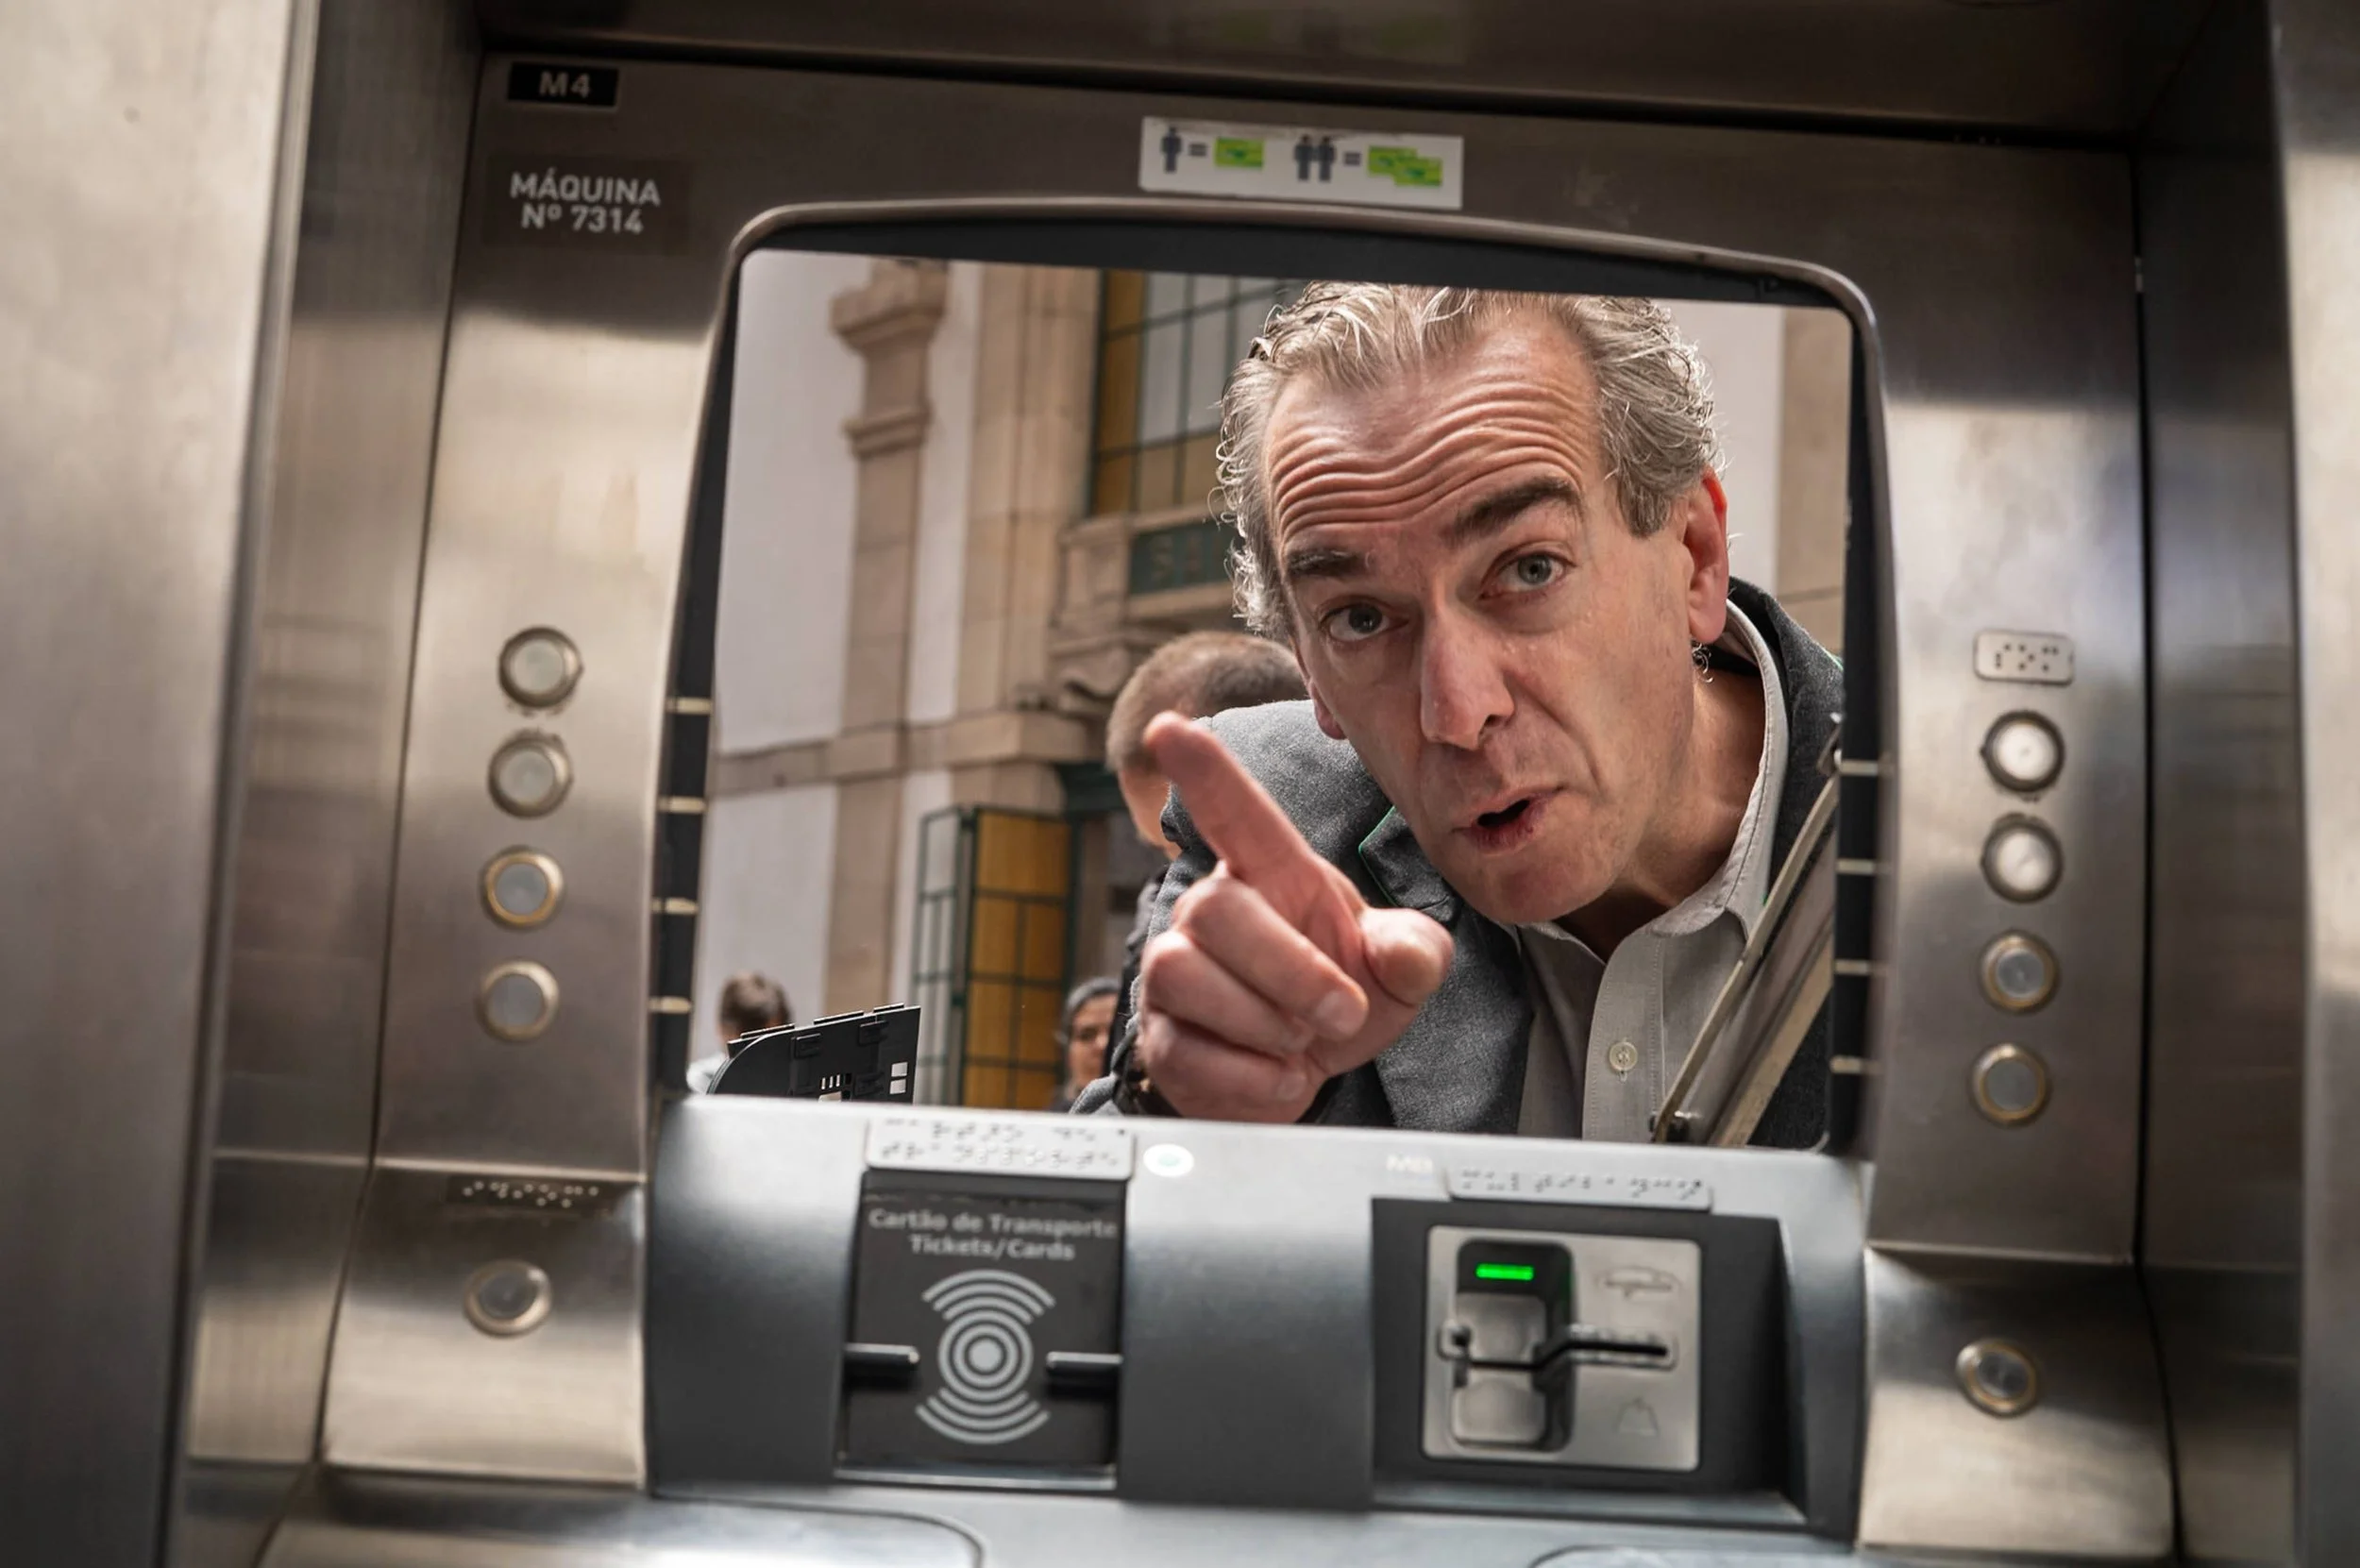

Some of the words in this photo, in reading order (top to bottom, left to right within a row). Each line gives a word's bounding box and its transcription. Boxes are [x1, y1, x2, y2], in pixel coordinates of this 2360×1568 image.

[539, 71, 591, 98] M4
[509, 166, 662, 207] MÁQUINA
[570, 204, 645, 234] 7314
[868, 1207, 949, 1231] Cartão
[952, 1212, 984, 1233] de
[988, 1213, 1118, 1241] Transporte
[907, 1233, 1077, 1261] Tickets/Cards
